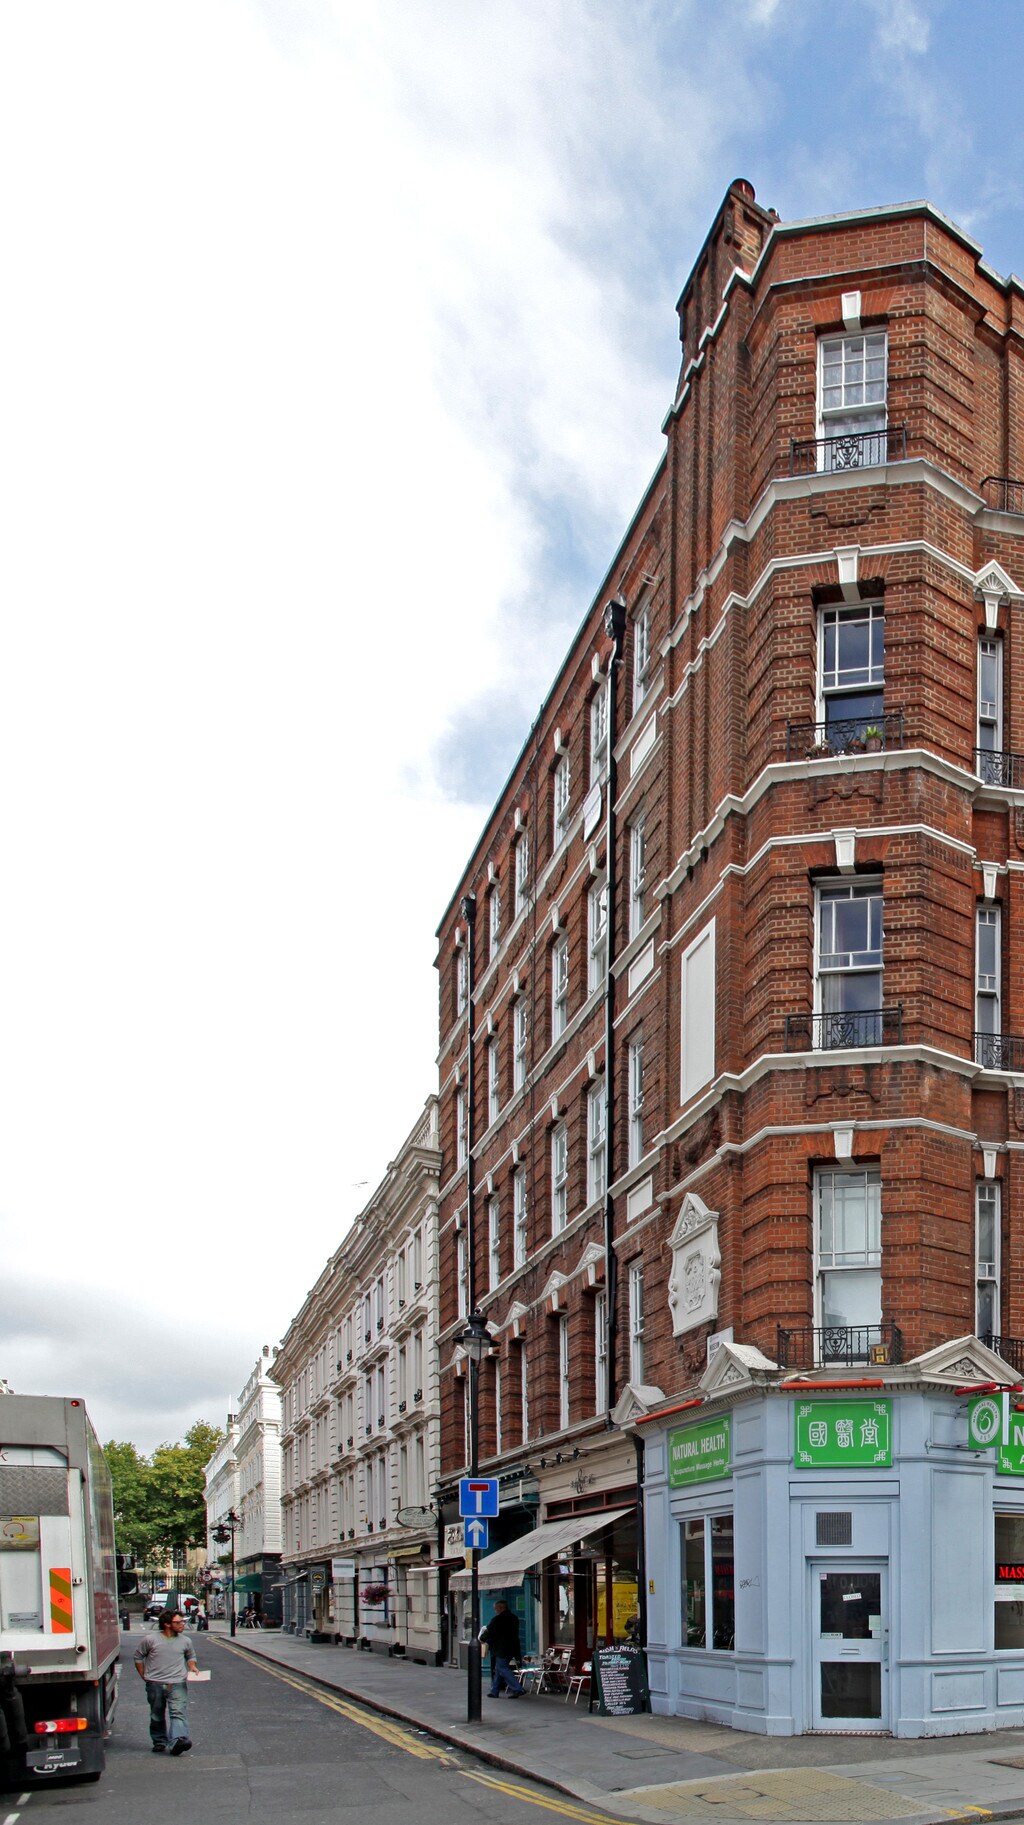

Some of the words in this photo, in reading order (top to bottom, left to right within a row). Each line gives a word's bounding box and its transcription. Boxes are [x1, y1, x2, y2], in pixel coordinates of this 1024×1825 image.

[673, 1441, 699, 1461] NATURAL
[701, 1433, 725, 1454] HEALTH
[809, 1419, 879, 1447] 國醫堂
[674, 1466, 695, 1475] Acupuncture
[696, 1462, 712, 1470] Massage
[713, 1458, 724, 1467] Herbs
